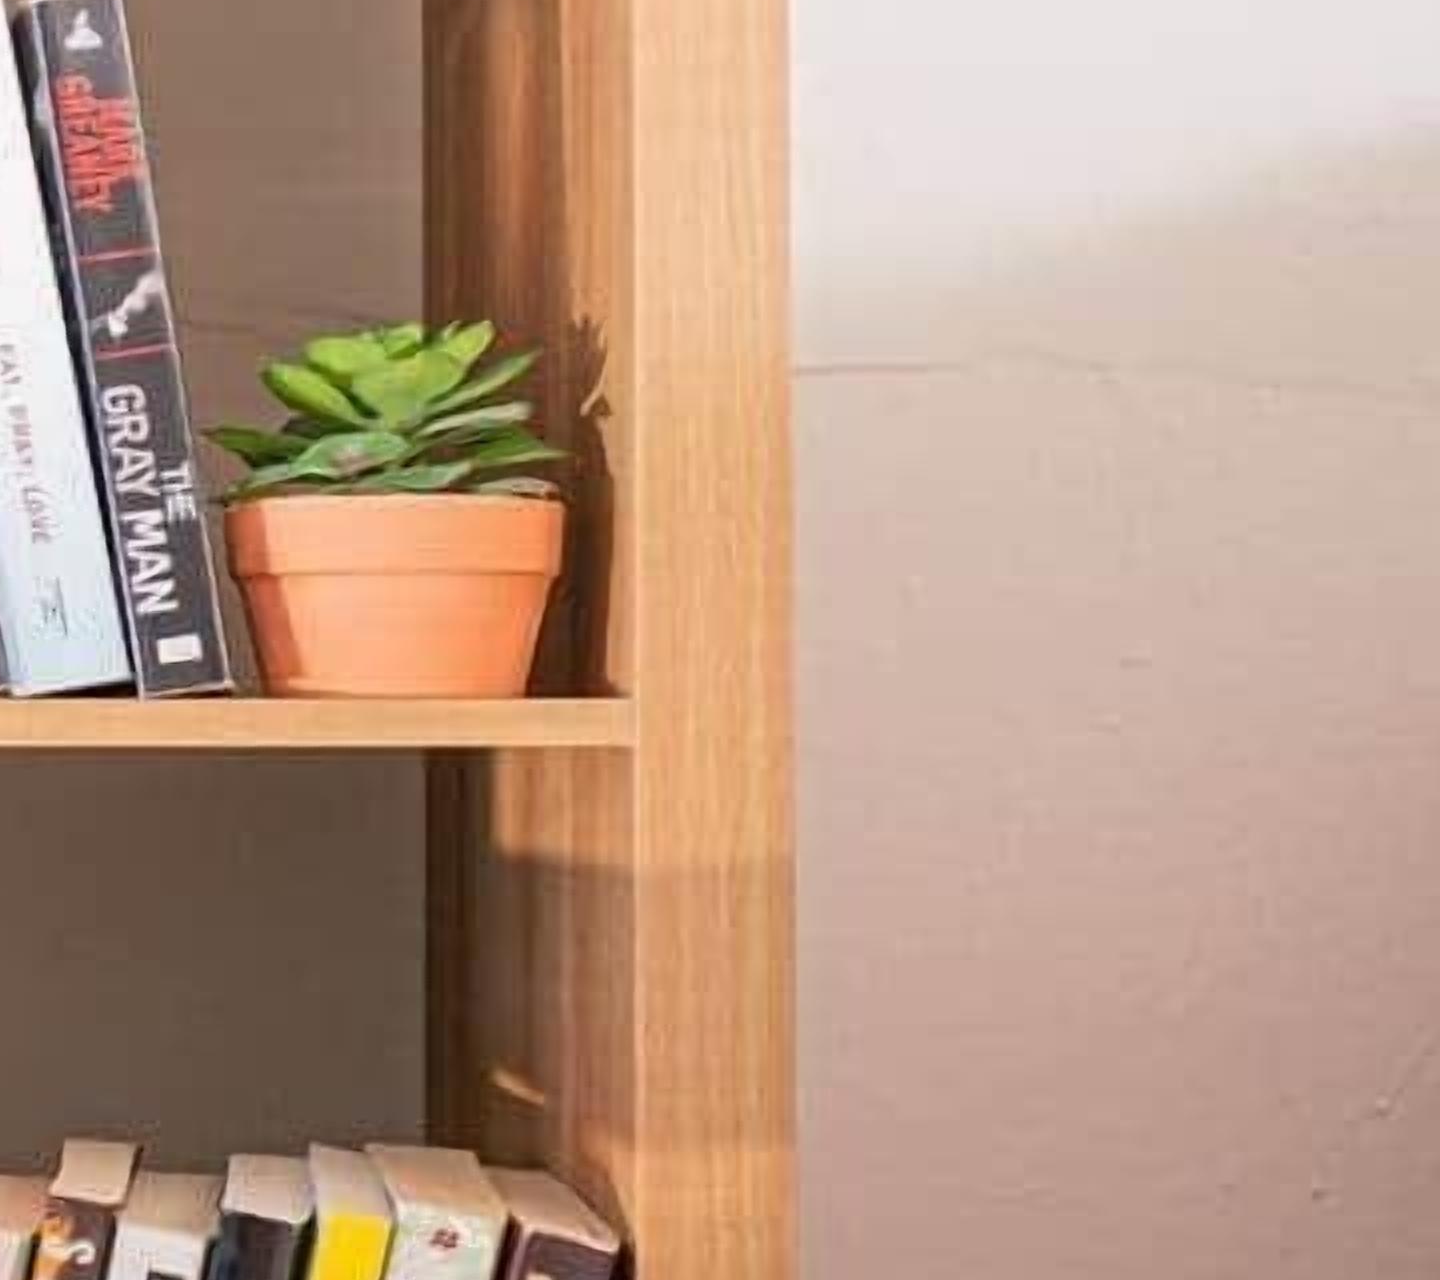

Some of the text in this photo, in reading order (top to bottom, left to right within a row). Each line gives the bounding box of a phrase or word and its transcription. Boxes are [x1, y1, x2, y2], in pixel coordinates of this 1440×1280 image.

[100, 381, 179, 617] GRAY MAN
[158, 461, 197, 523] THE
